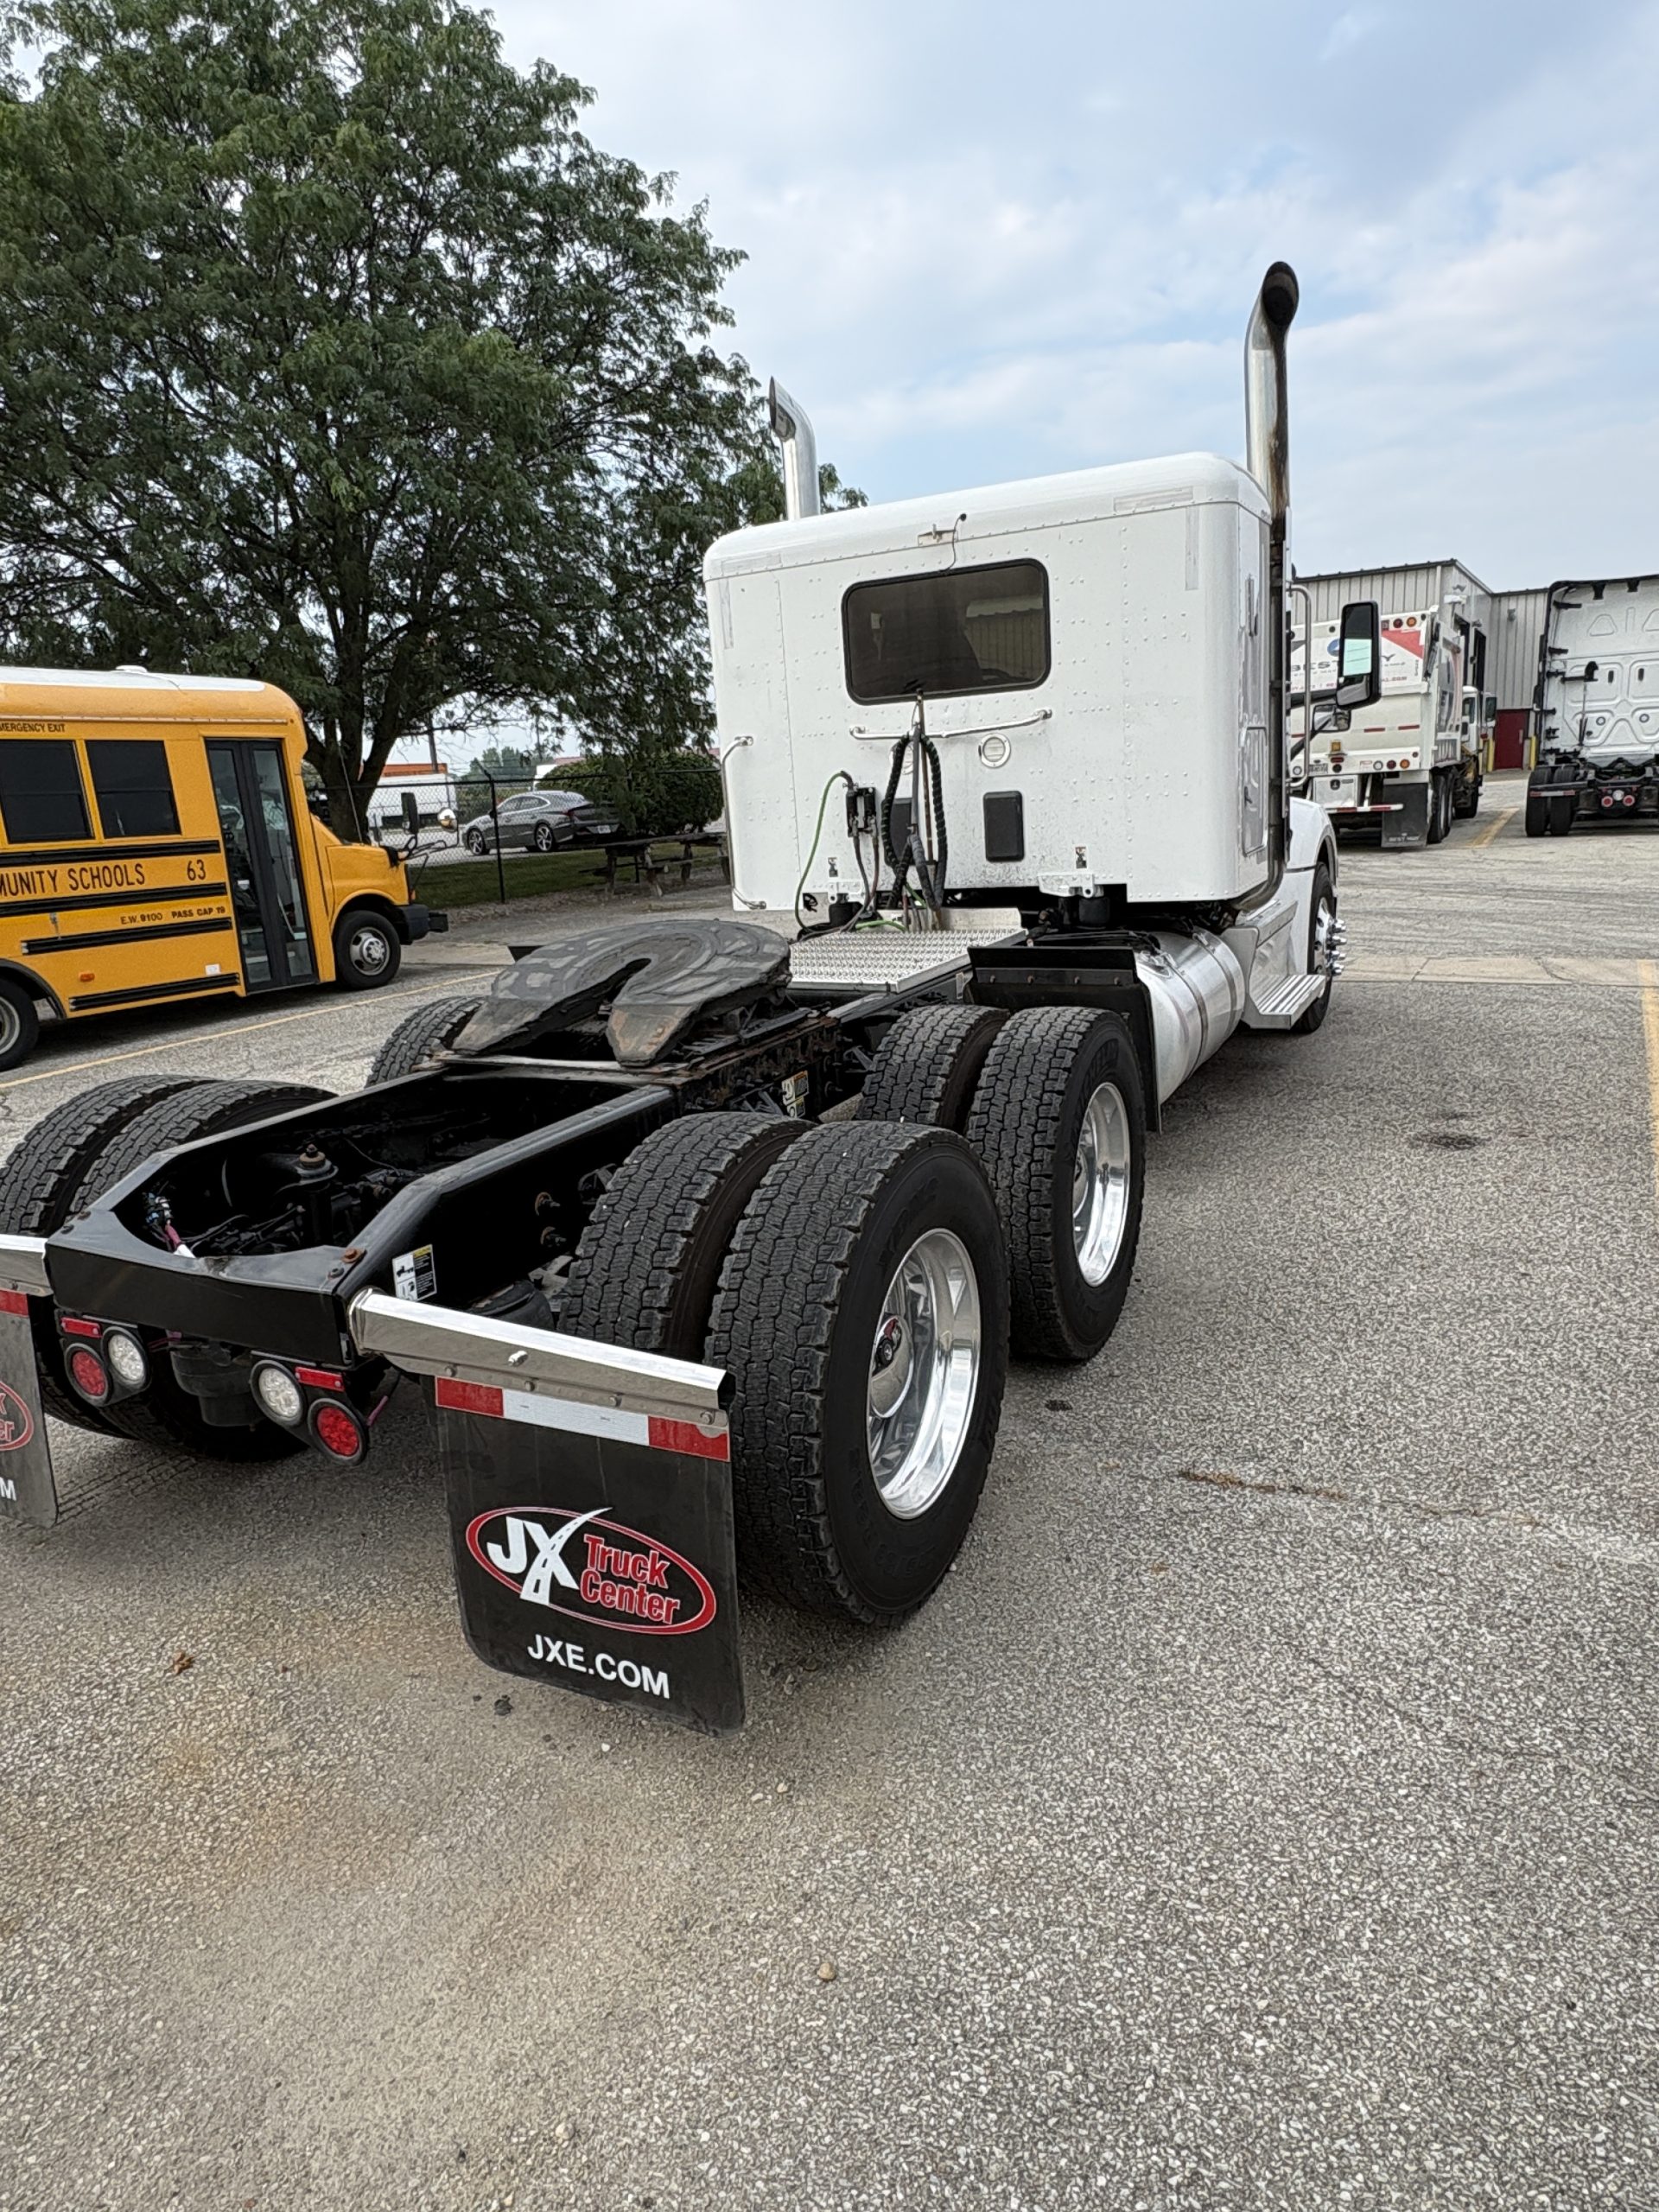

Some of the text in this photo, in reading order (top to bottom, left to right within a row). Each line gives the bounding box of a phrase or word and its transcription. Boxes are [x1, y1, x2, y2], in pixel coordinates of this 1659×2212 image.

[48, 723, 66, 733] EXIT
[67, 862, 145, 891] SCHOOLS
[187, 859, 207, 880] 63
[171, 909, 194, 918] PASS
[196, 907, 213, 917] CAP
[486, 1507, 613, 1605] JX
[583, 1534, 671, 1589] Truck
[580, 1567, 681, 1625] Center
[527, 1633, 671, 1699] JXE.COM
